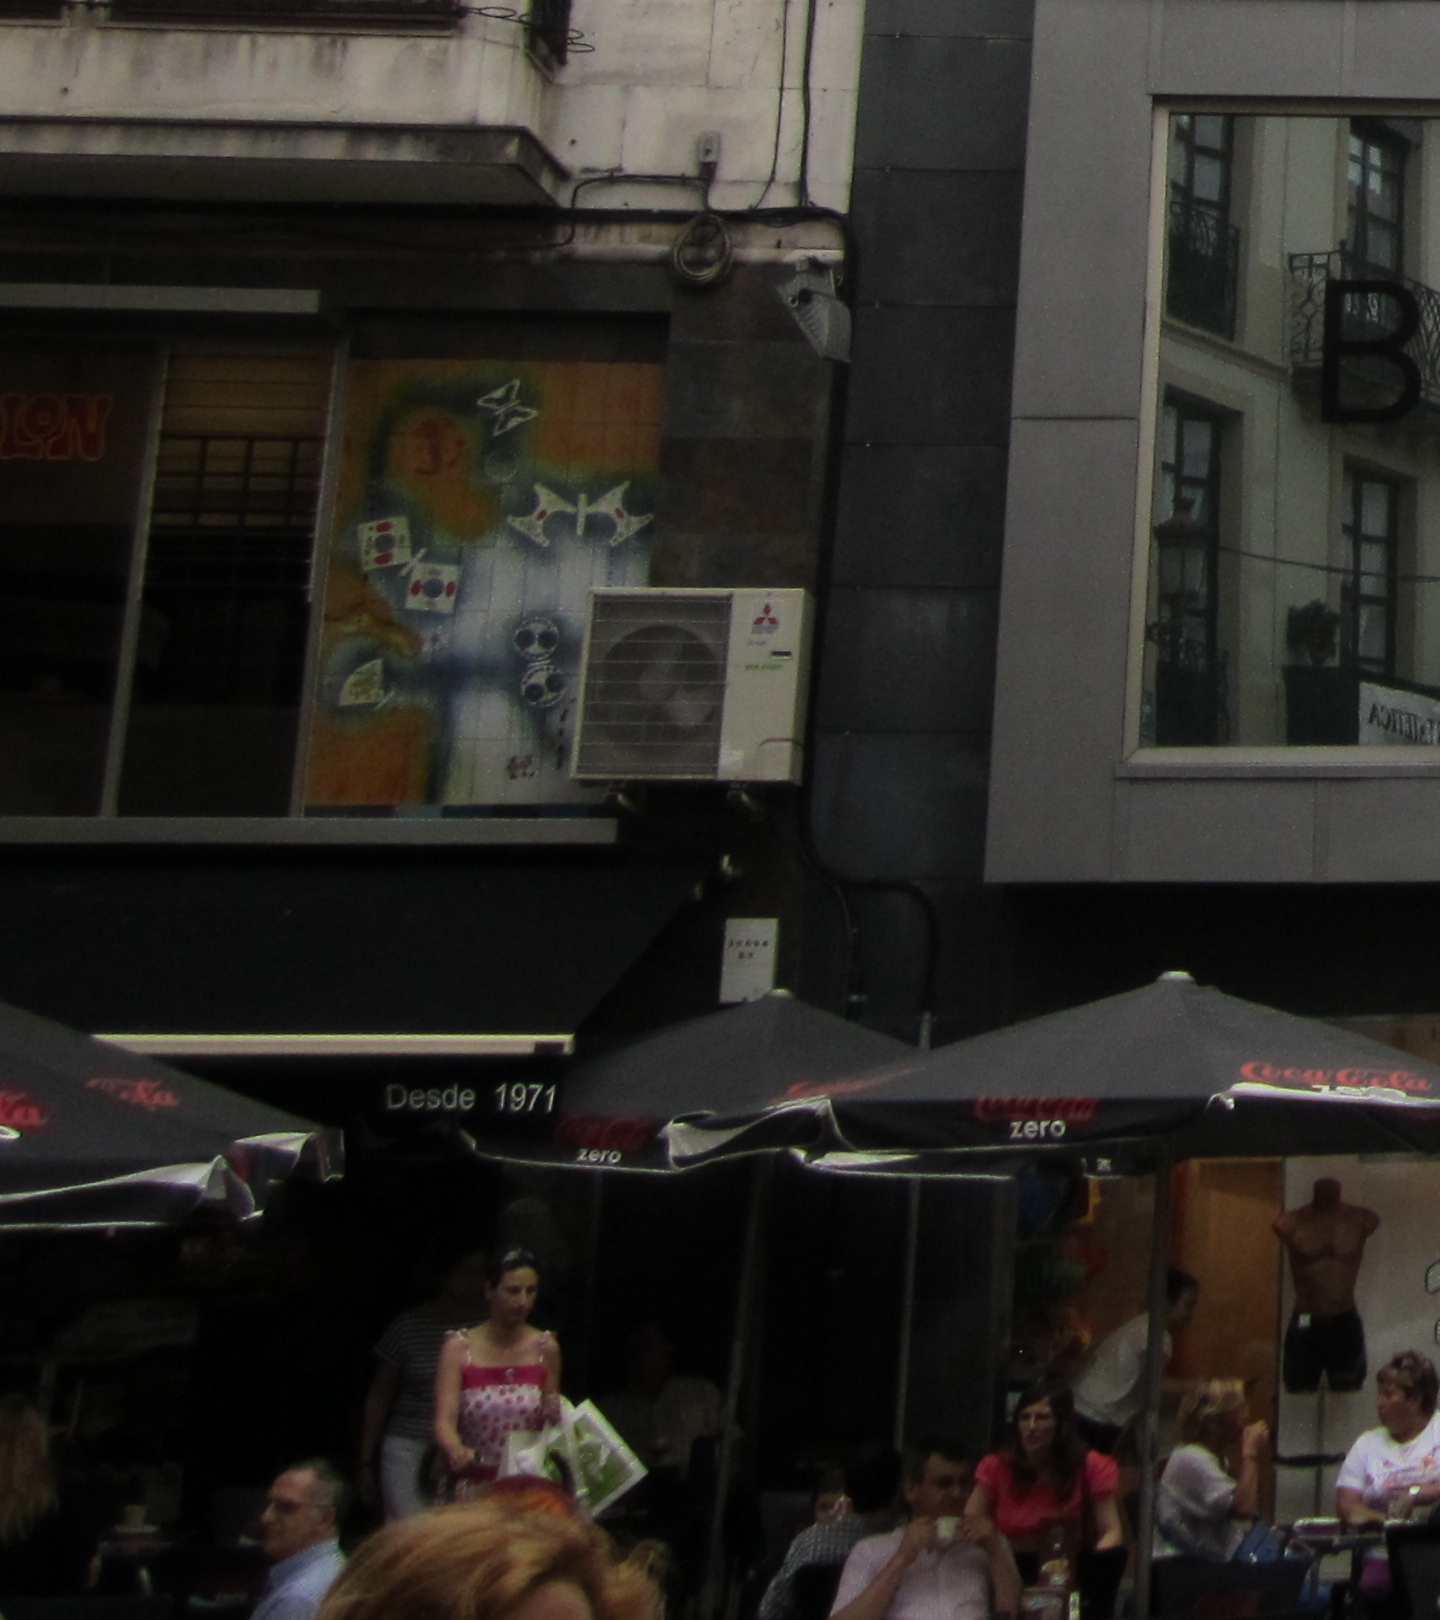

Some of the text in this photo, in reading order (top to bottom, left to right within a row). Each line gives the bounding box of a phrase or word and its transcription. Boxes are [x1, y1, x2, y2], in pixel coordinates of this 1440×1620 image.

[385, 1082, 558, 1113] Desde 1971
[1009, 1119, 1066, 1140] zero
[576, 1147, 623, 1164] zero
